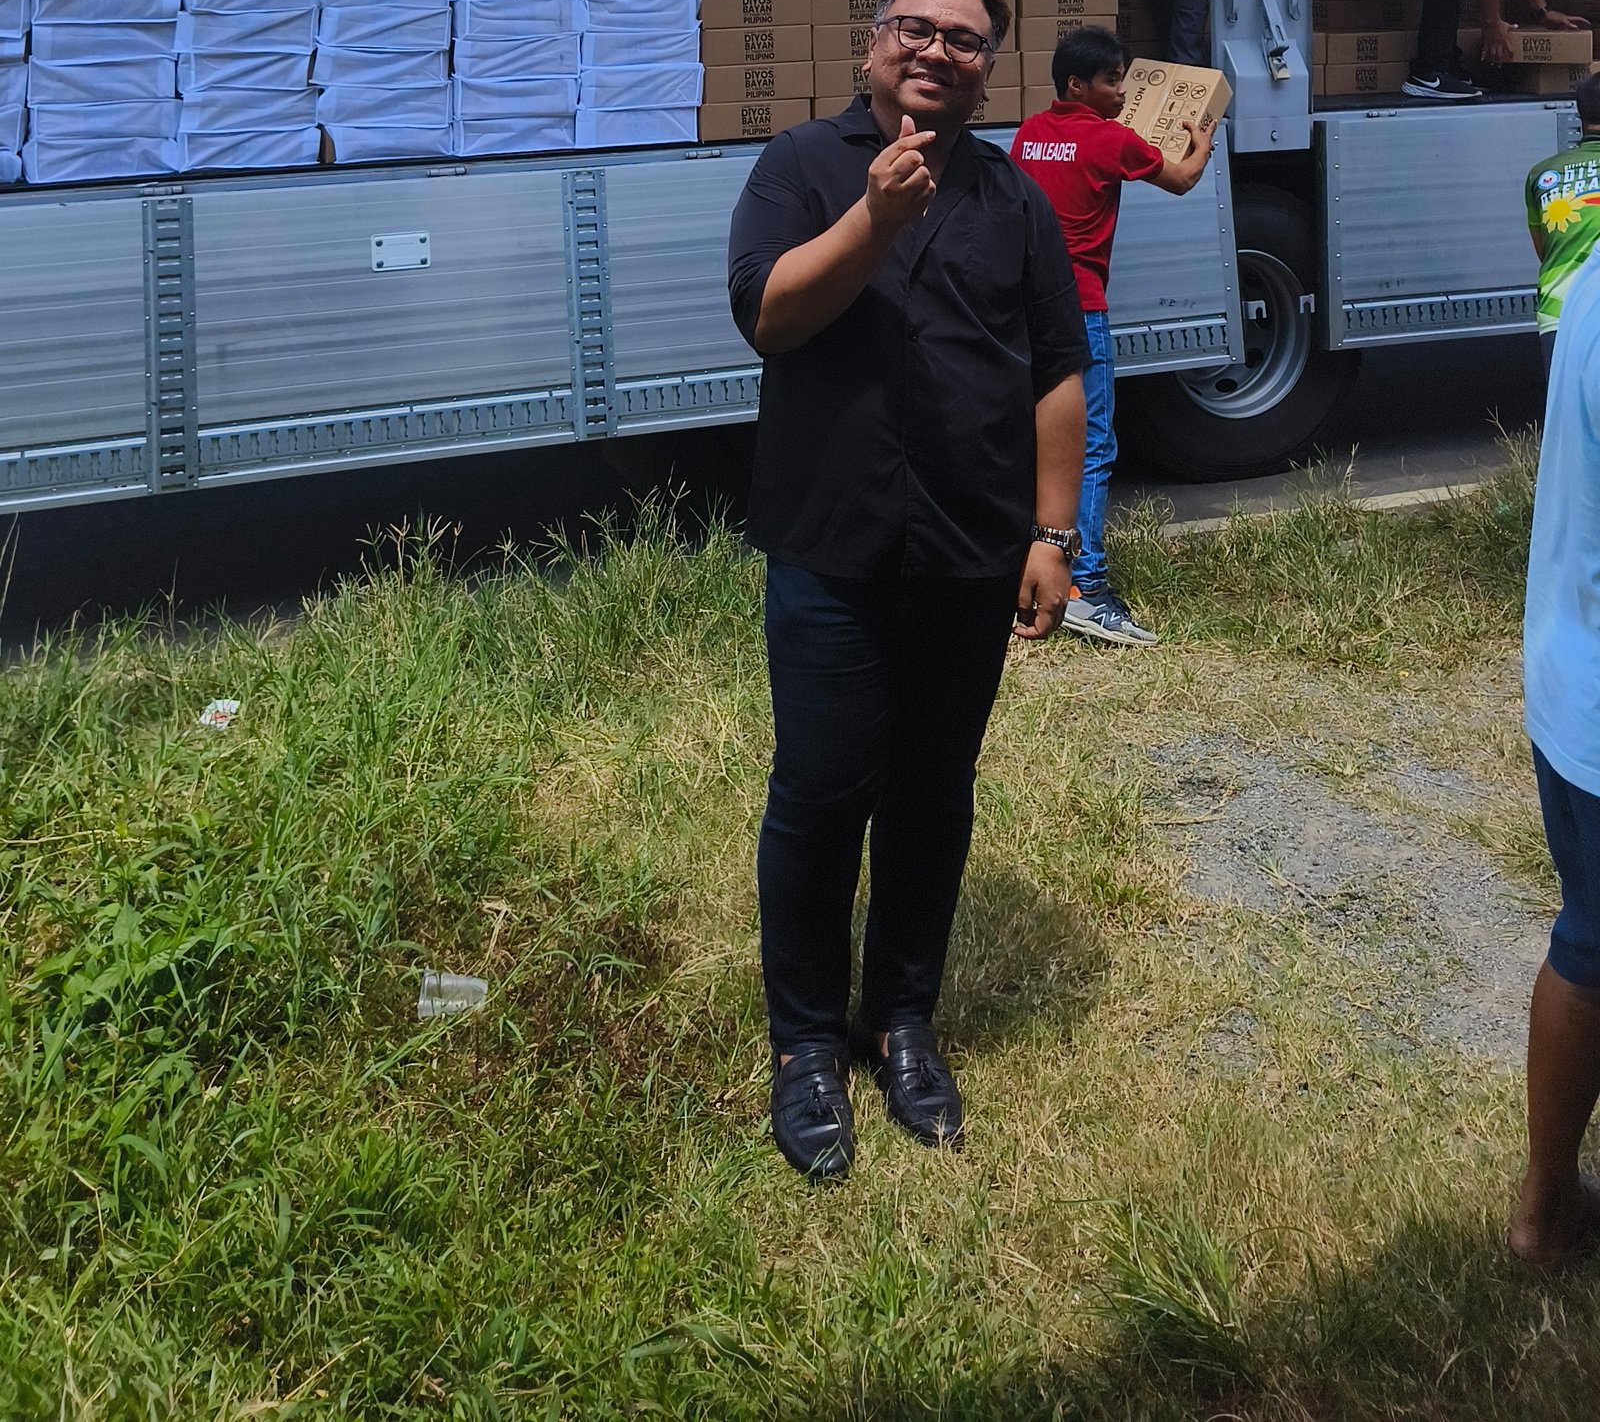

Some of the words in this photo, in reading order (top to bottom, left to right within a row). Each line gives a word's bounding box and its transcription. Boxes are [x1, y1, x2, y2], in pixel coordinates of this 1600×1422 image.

[743, 4, 772, 13] BAYAN
[849, 1, 877, 10] BAYAN
[744, 16, 772, 24] PILIPINO
[745, 41, 774, 51] BAYAN
[745, 52, 774, 61] PILIPINO
[745, 79, 774, 88] BAYAN
[746, 90, 775, 98] PILIPINO
[1130, 87, 1146, 107] NOT
[742, 116, 771, 125] BAYAN
[743, 127, 771, 136] PILIPINO
[1021, 141, 1042, 161] TEAM
[1042, 142, 1077, 162] LEADER
